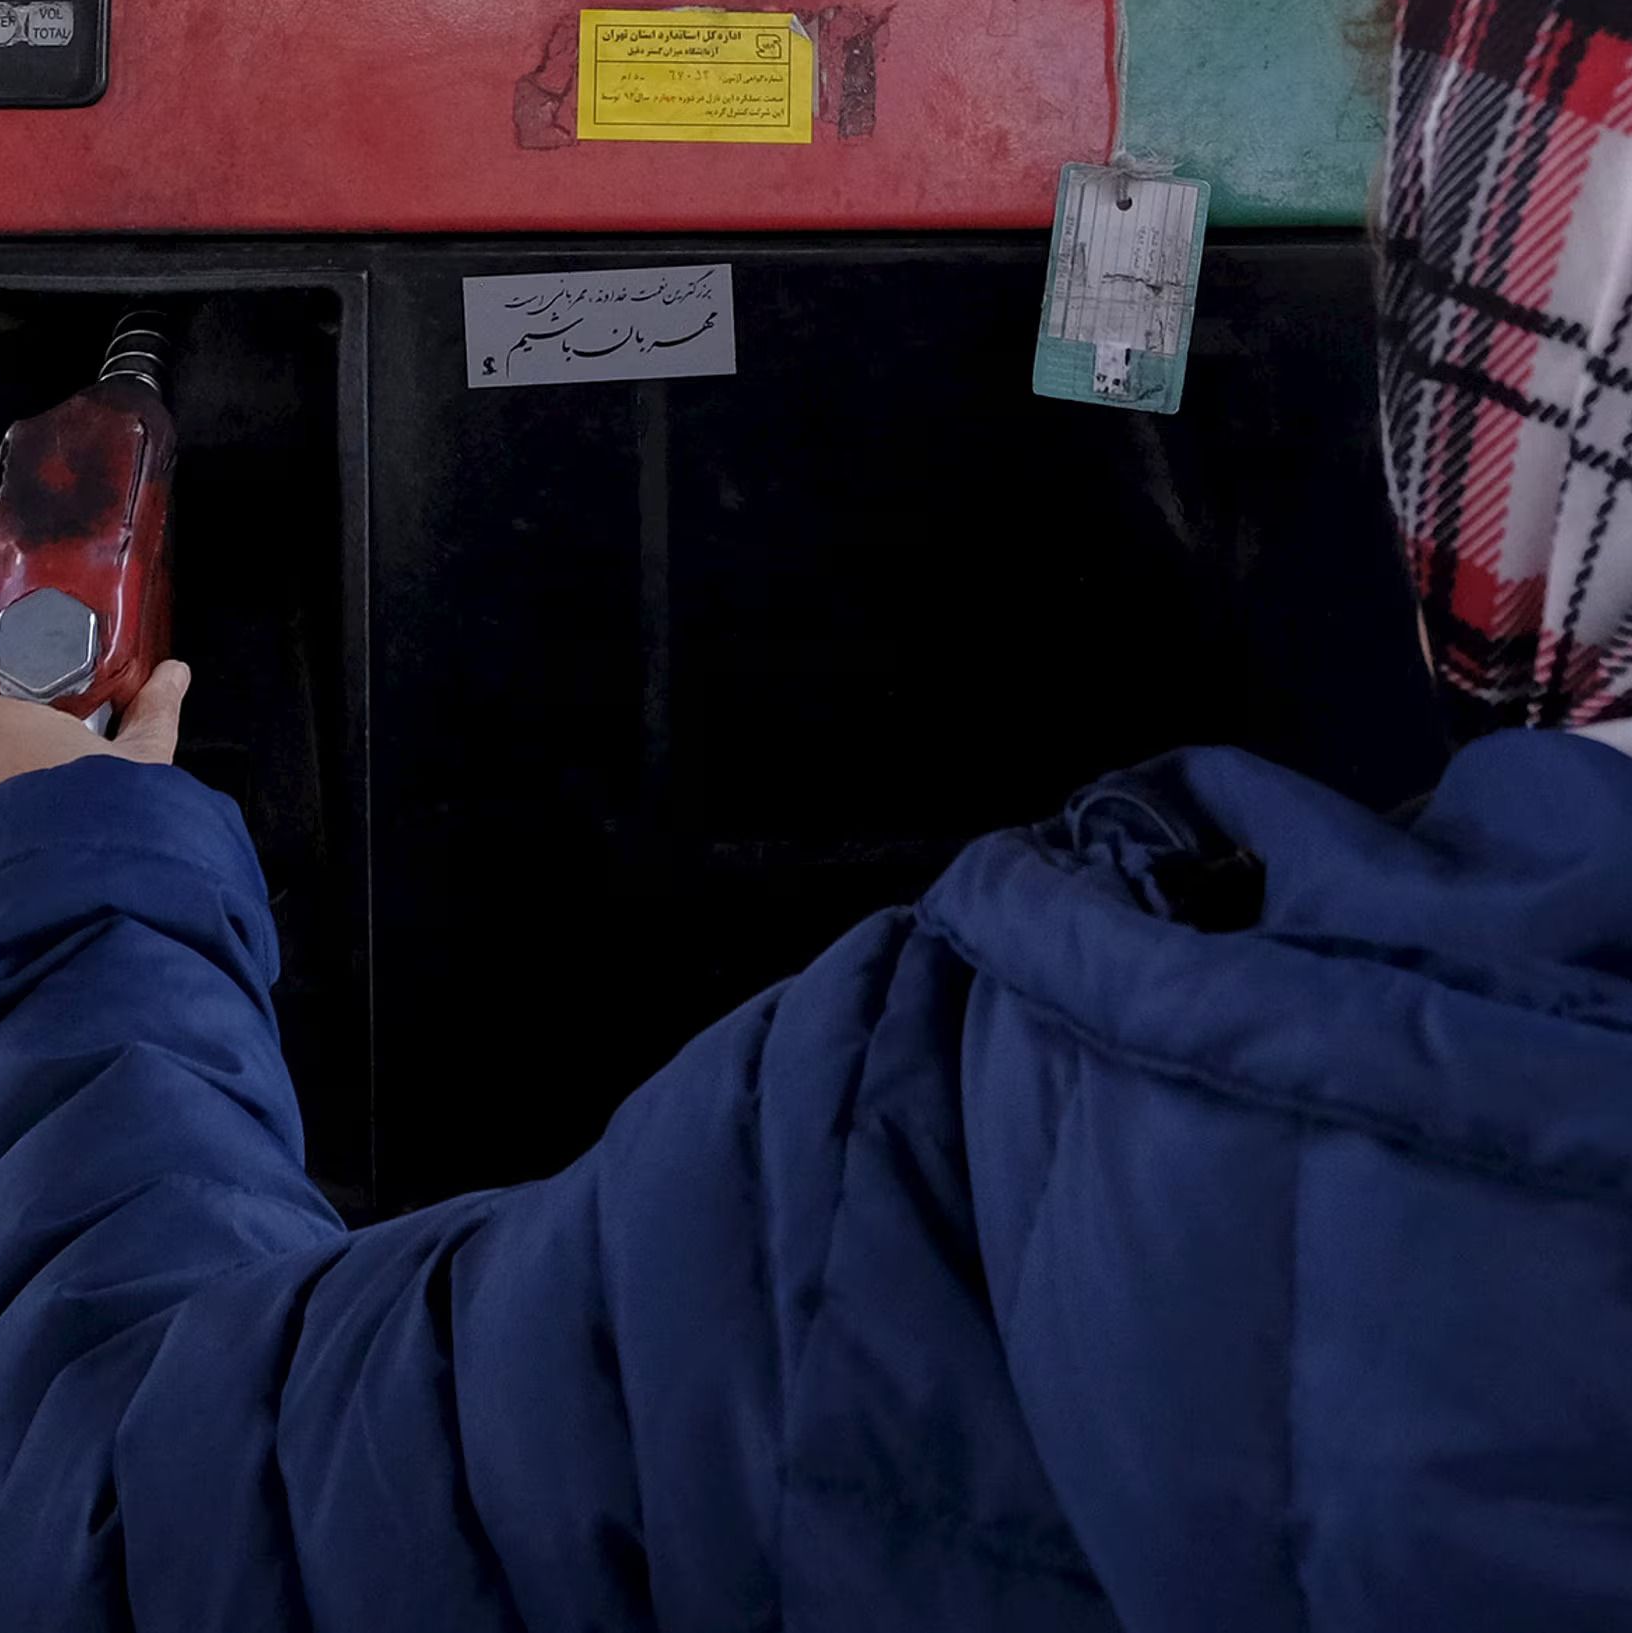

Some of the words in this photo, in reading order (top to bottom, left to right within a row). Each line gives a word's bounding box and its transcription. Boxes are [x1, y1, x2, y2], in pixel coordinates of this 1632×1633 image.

[39, 8, 63, 20] VOL
[33, 27, 69, 40] TOTAL
[602, 28, 628, 42] تهران
[571, 311, 718, 359] مهربان
[505, 311, 584, 379] باشیم
